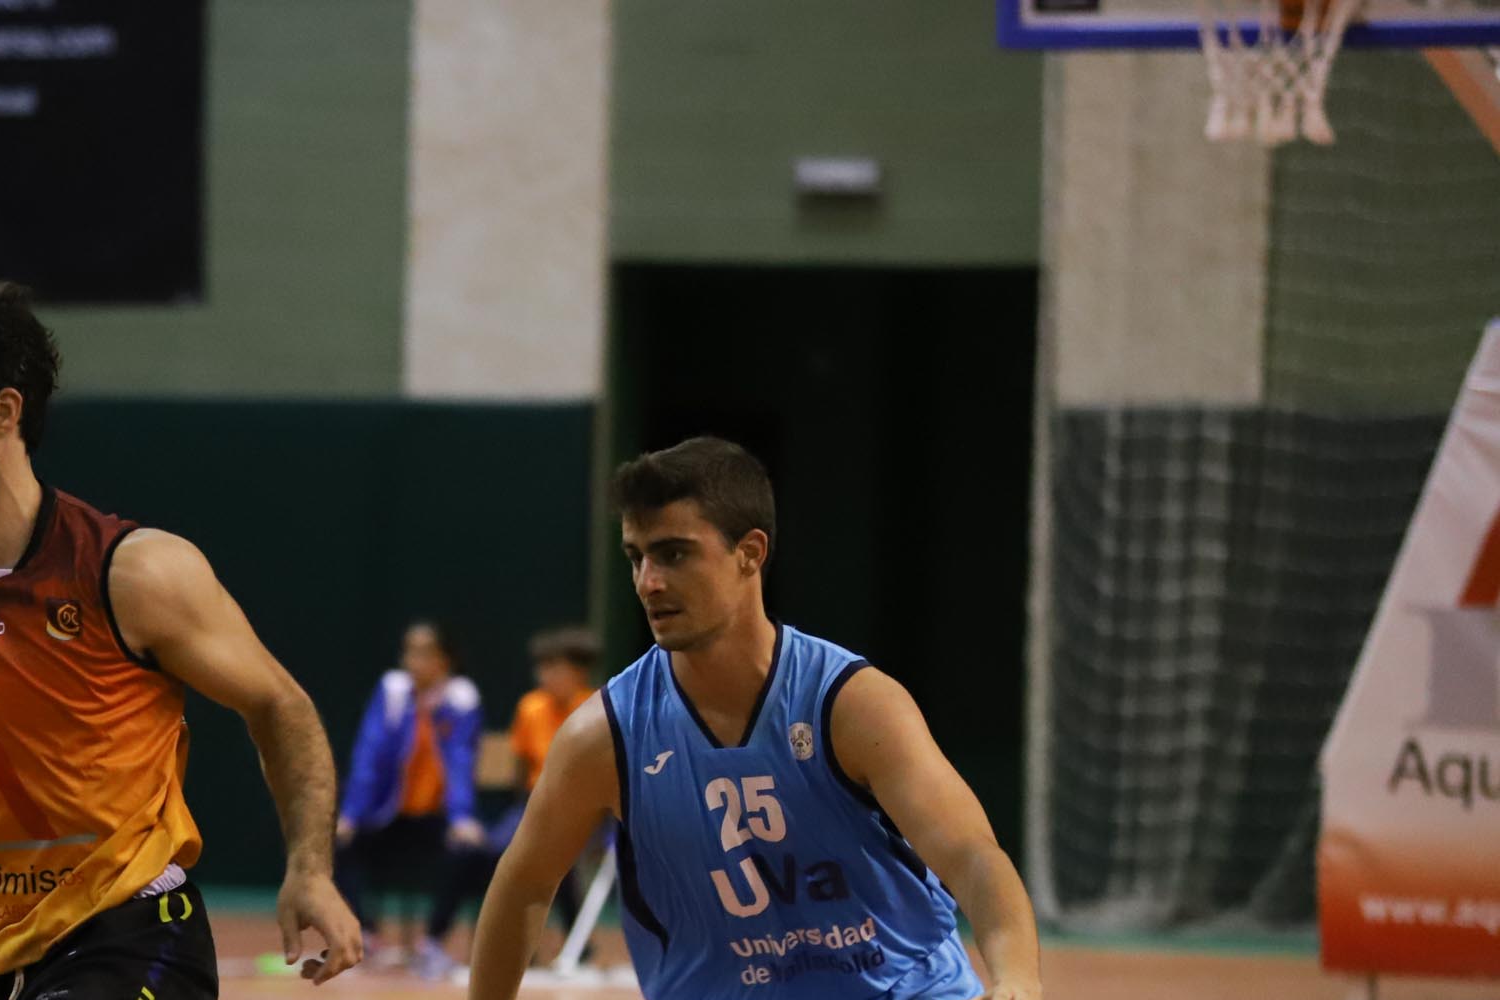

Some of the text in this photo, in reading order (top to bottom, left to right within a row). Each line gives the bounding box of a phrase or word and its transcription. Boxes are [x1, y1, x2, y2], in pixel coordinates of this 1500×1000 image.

[1387, 735, 1500, 812] Aqu
[704, 775, 787, 853] 25
[730, 917, 877, 958] Universdad
[741, 963, 772, 985] de
